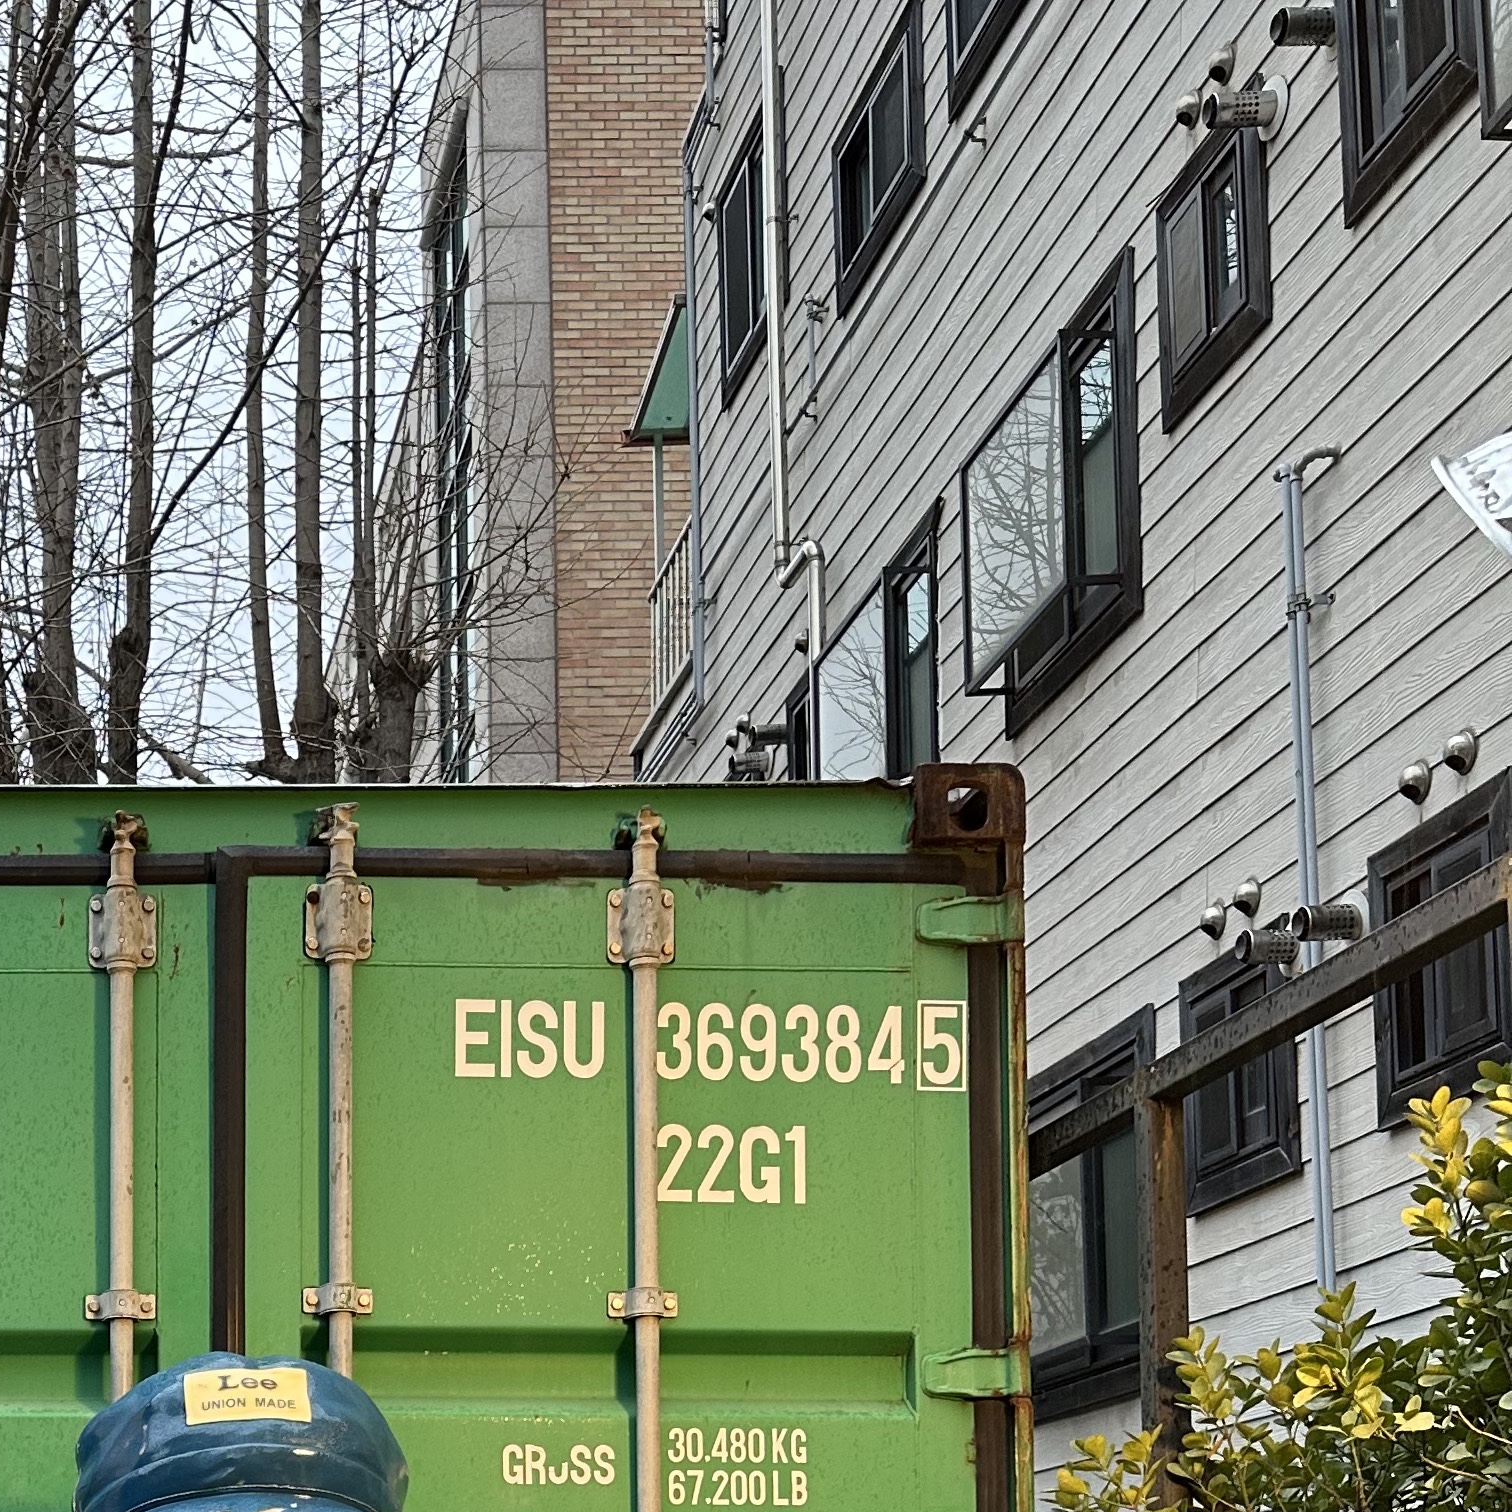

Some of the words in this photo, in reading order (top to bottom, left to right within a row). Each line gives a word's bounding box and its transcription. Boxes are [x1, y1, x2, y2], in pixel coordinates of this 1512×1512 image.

[455, 998, 605, 1079] EISU
[657, 1124, 806, 1203] 22G1
[218, 1375, 278, 1391] Lee
[201, 1398, 246, 1411] UNION
[255, 1397, 296, 1409] MADE
[668, 1428, 765, 1464] 30.480
[772, 1428, 807, 1464] KG
[668, 1470, 766, 1505] 67.200
[773, 1471, 808, 1506] LB
